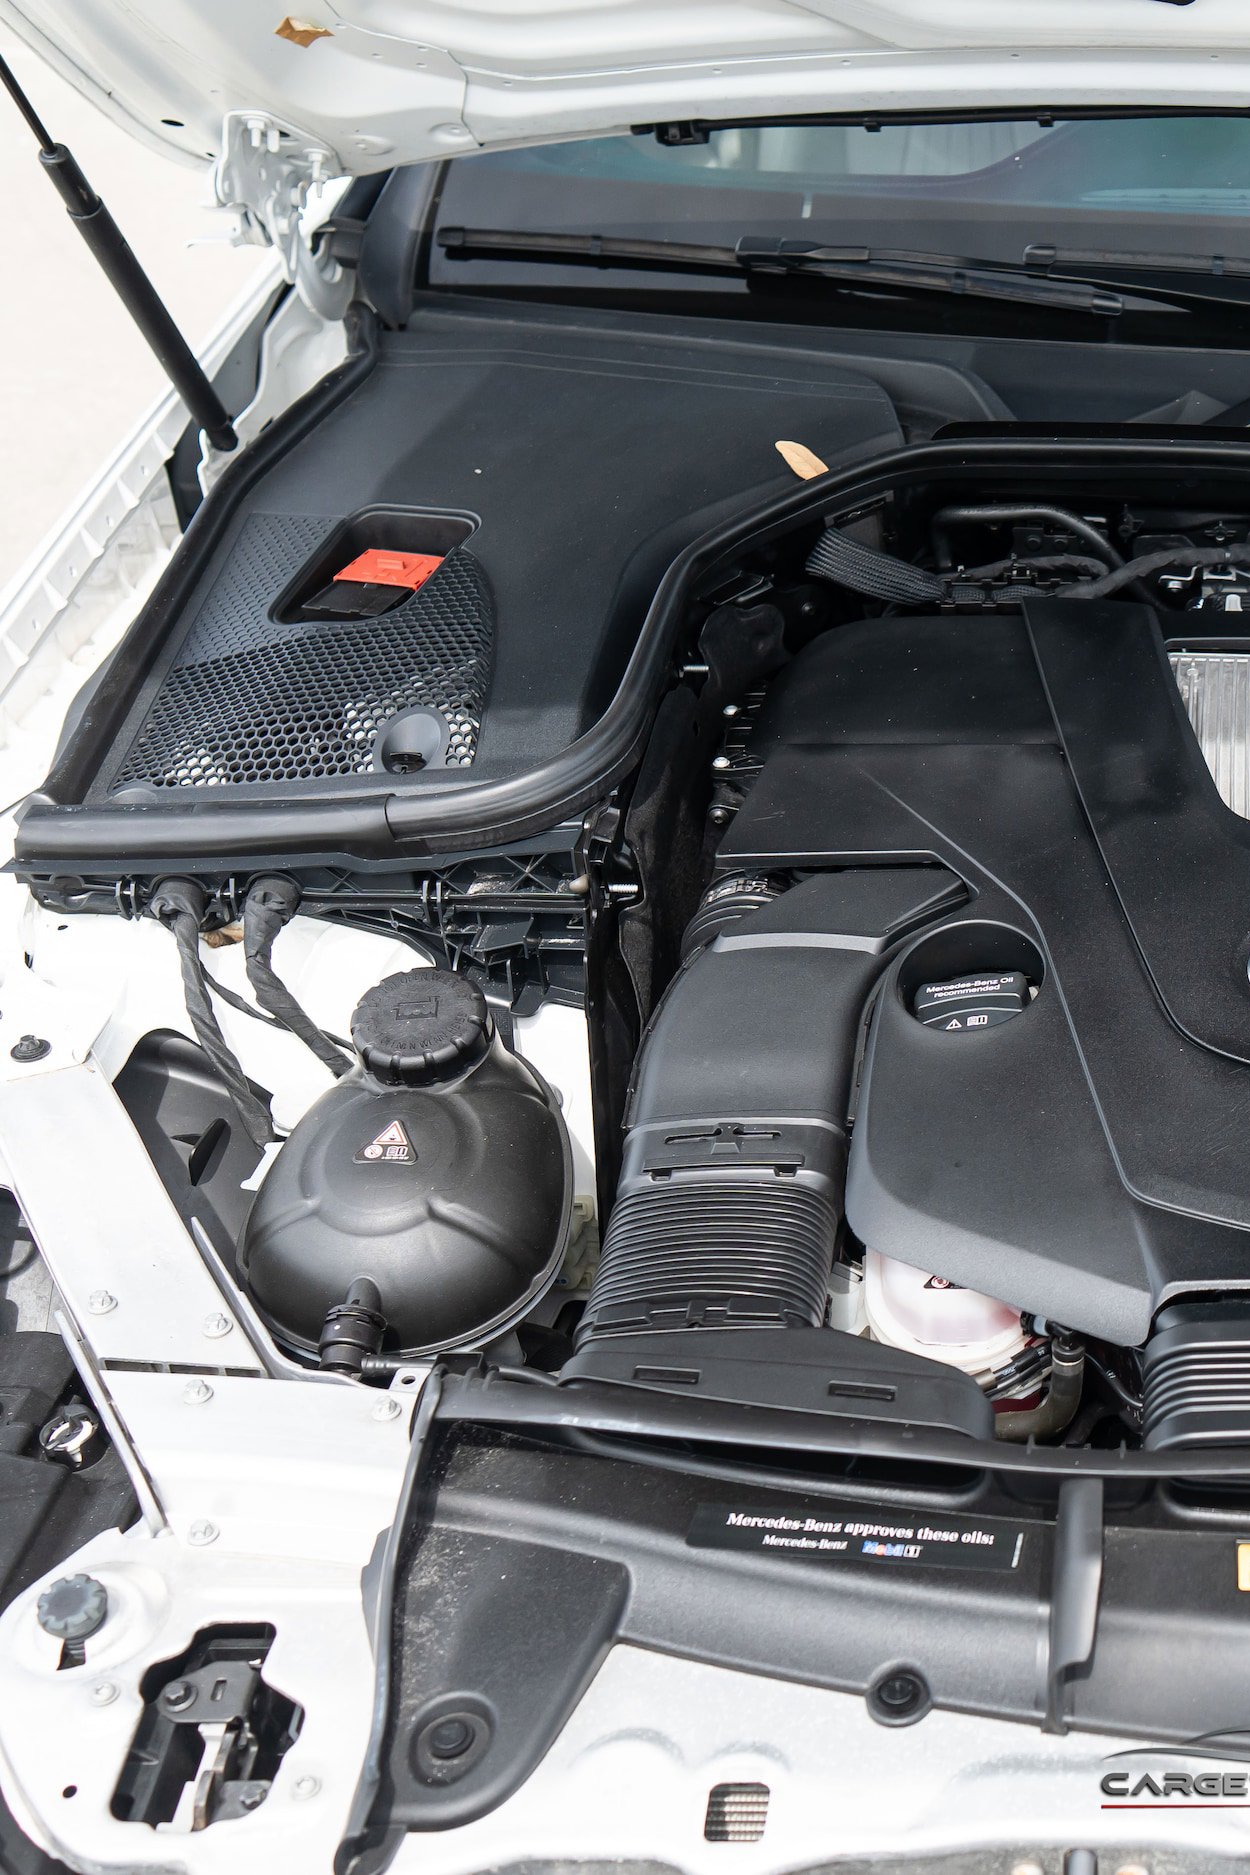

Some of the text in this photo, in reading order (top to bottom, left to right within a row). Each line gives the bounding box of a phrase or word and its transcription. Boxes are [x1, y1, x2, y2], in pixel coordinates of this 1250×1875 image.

[926, 976, 1014, 994] Mercedes-Benz Oil
[934, 984, 1000, 998] recommended
[726, 1512, 995, 1546] Mercedes-Benz approves these oils:
[762, 1534, 848, 1550] Mercedes-Benz
[861, 1540, 905, 1557] Mobil
